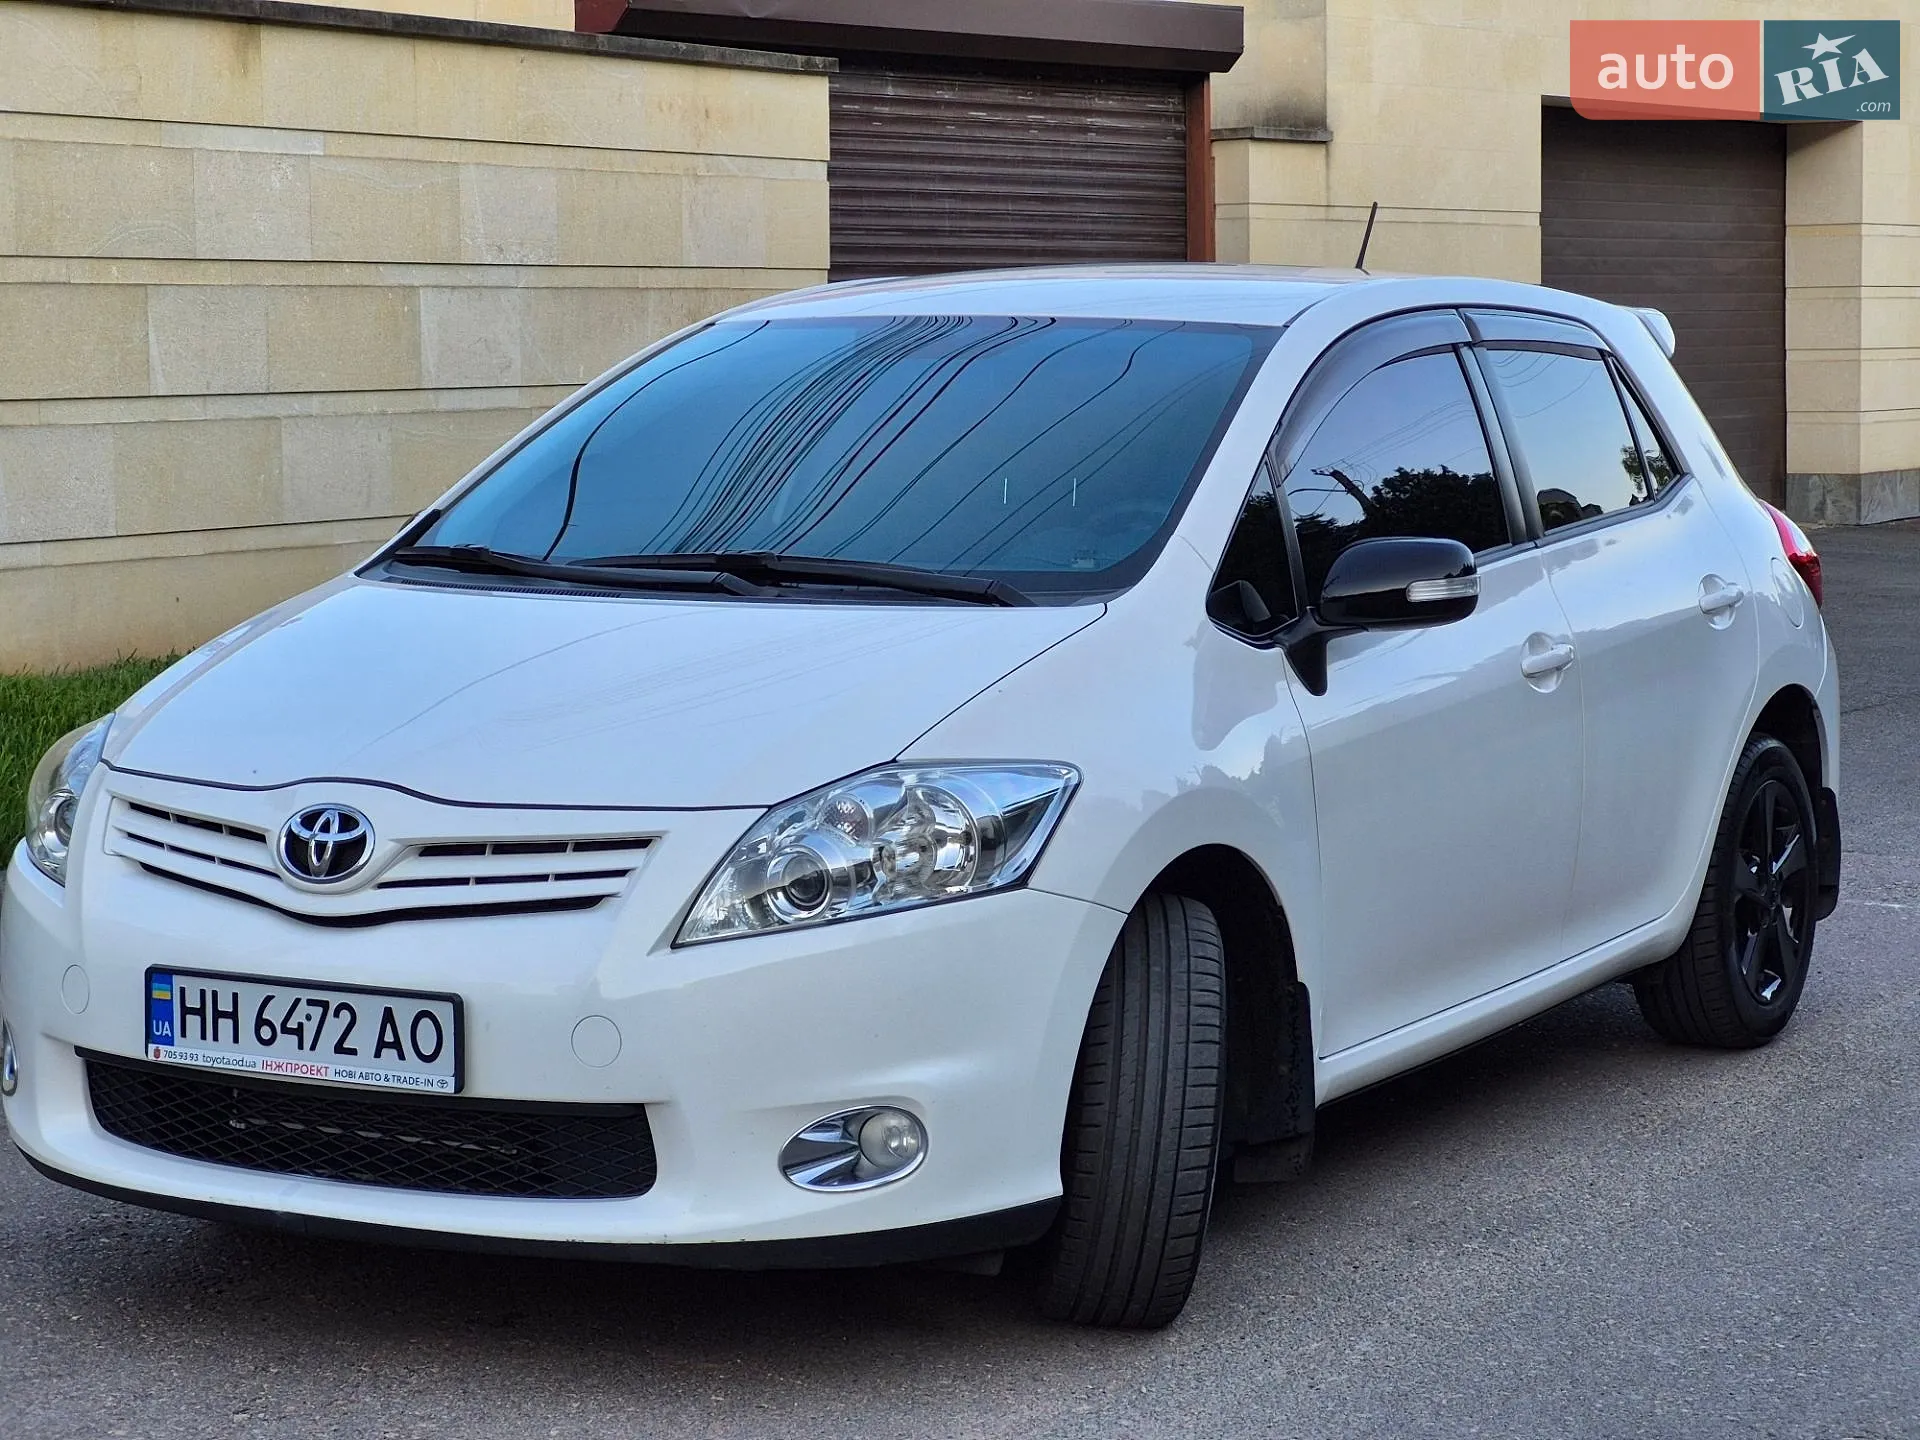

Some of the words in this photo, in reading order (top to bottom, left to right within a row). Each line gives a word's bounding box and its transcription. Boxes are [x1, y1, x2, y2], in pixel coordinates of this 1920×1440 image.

[152, 1019, 172, 1037] UA
[179, 986, 239, 1044] HH
[254, 995, 358, 1056] 6472
[373, 1006, 443, 1063] AO
[202, 1053, 257, 1069] toyota.od.ua
[383, 1073, 391, 1083] &
[392, 1074, 434, 1088] TRADE-IN
